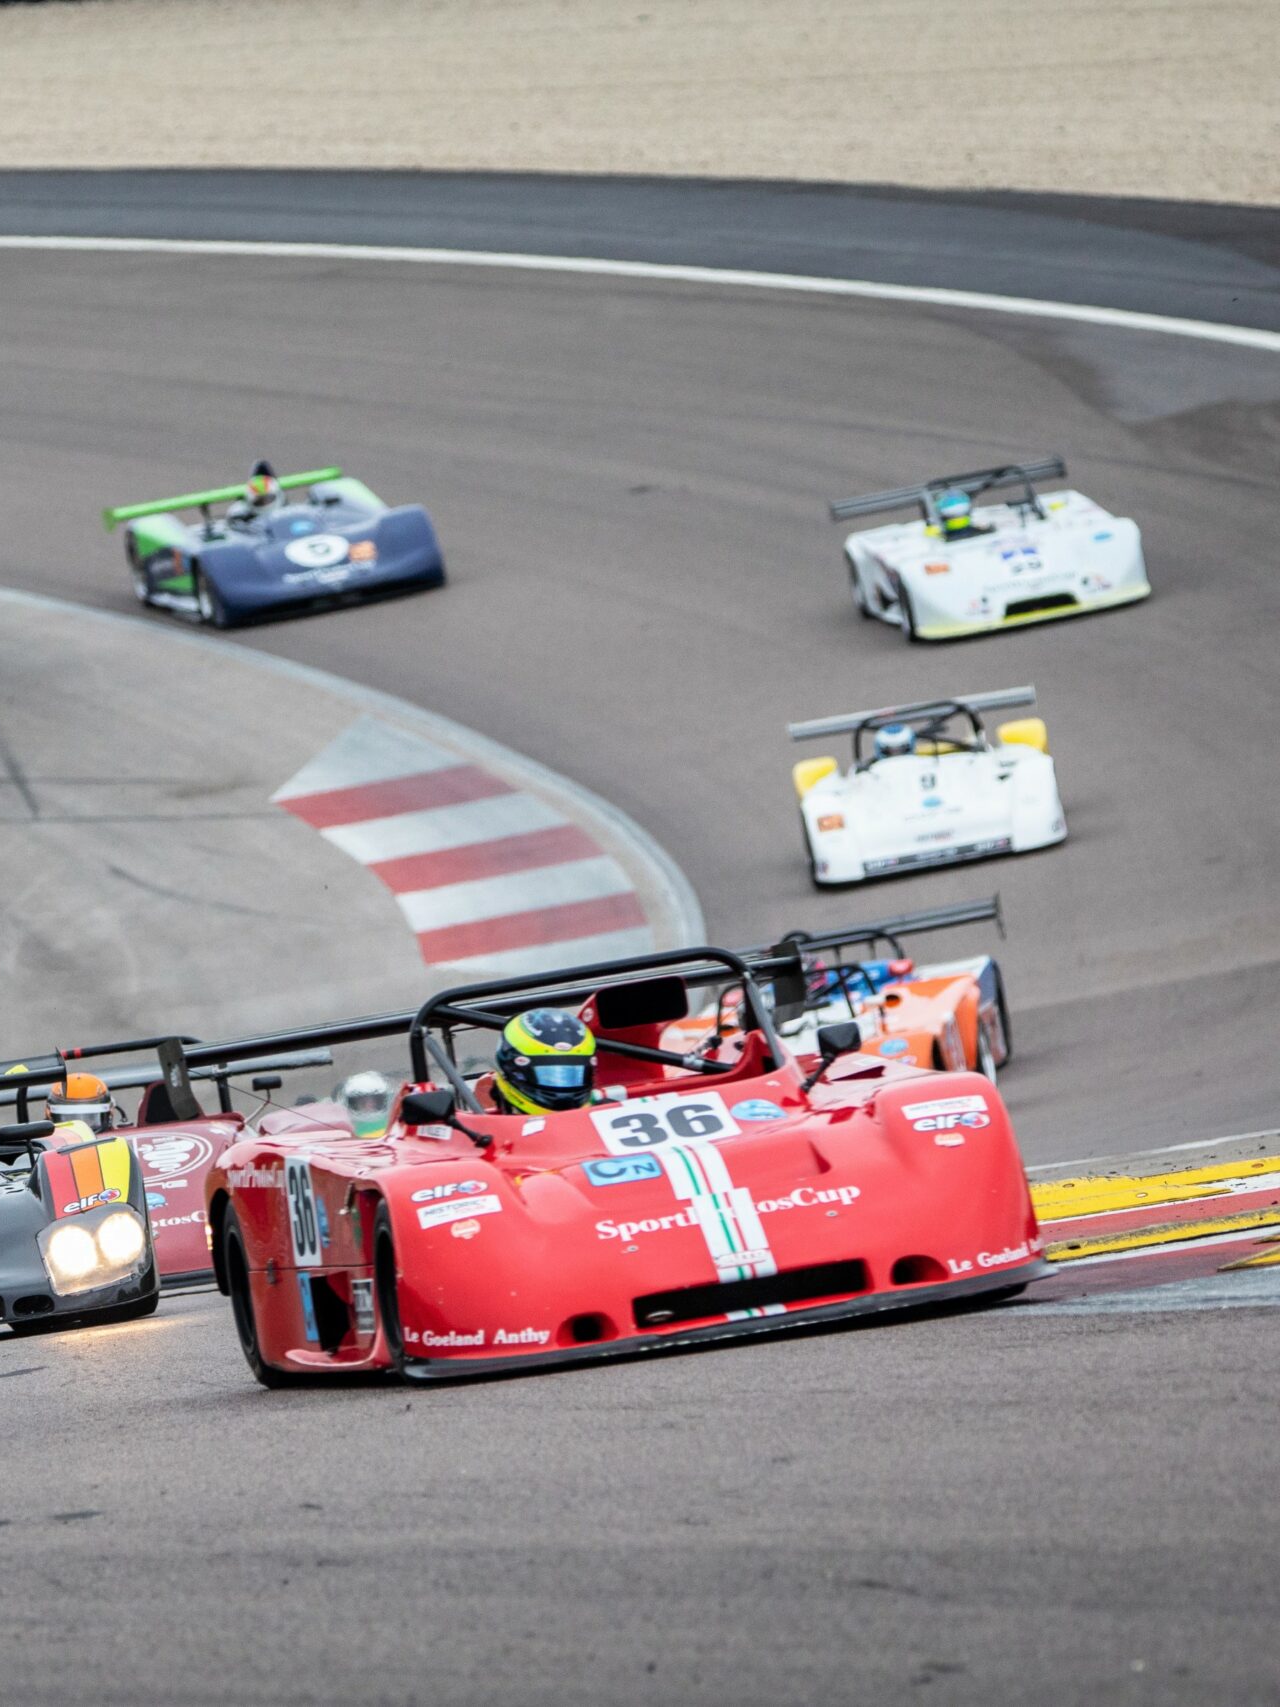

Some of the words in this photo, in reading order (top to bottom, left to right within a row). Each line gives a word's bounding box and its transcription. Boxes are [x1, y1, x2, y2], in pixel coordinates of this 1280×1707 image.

[610, 1104, 724, 1147] 36
[913, 1113, 961, 1132] elf
[589, 1160, 656, 1178] CN
[411, 1183, 460, 1202] elf
[63, 1193, 100, 1213] elf
[288, 1165, 317, 1257] 36
[947, 1258, 974, 1274] Le
[404, 1327, 420, 1343] Le
[422, 1329, 485, 1347] Goeland
[493, 1327, 551, 1345] Anthy
